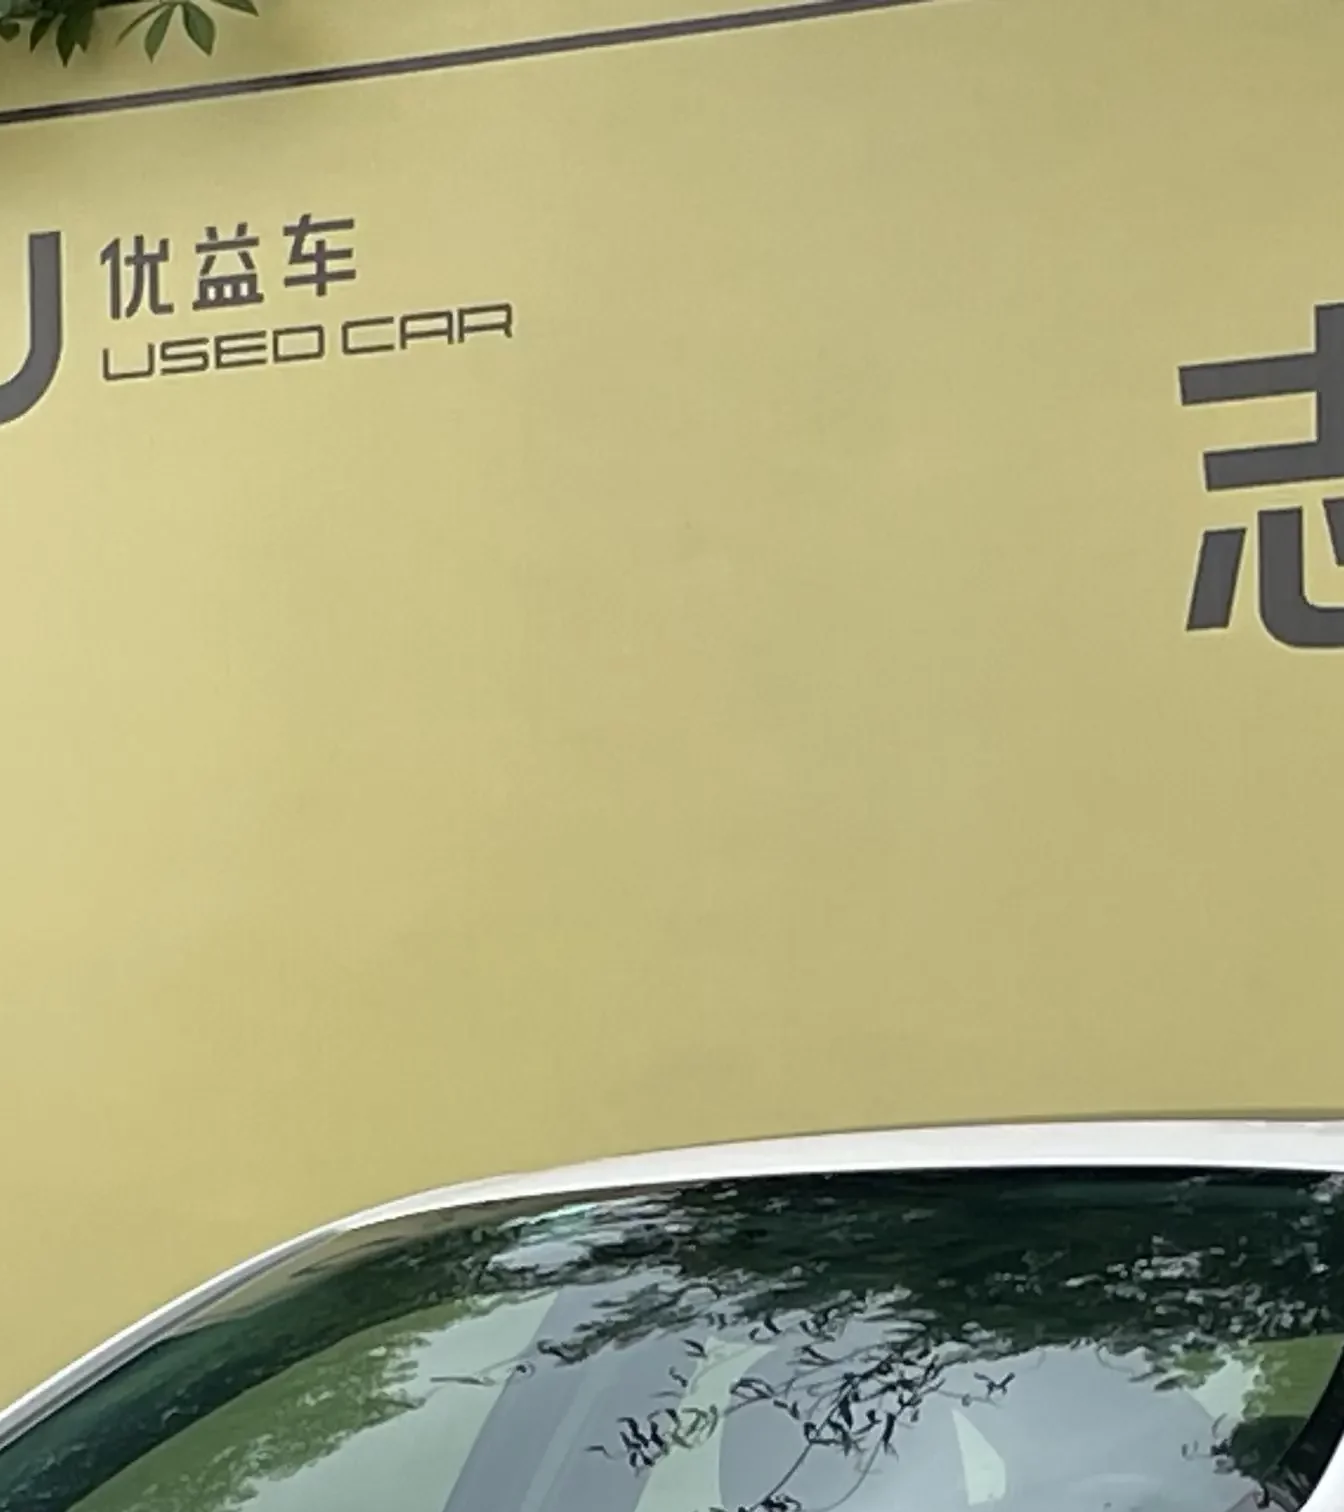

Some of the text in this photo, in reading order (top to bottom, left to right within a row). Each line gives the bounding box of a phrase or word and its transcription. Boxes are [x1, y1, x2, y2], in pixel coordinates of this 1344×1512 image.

[99, 213, 357, 320] 优益车
[102, 302, 514, 381] USED CAR
